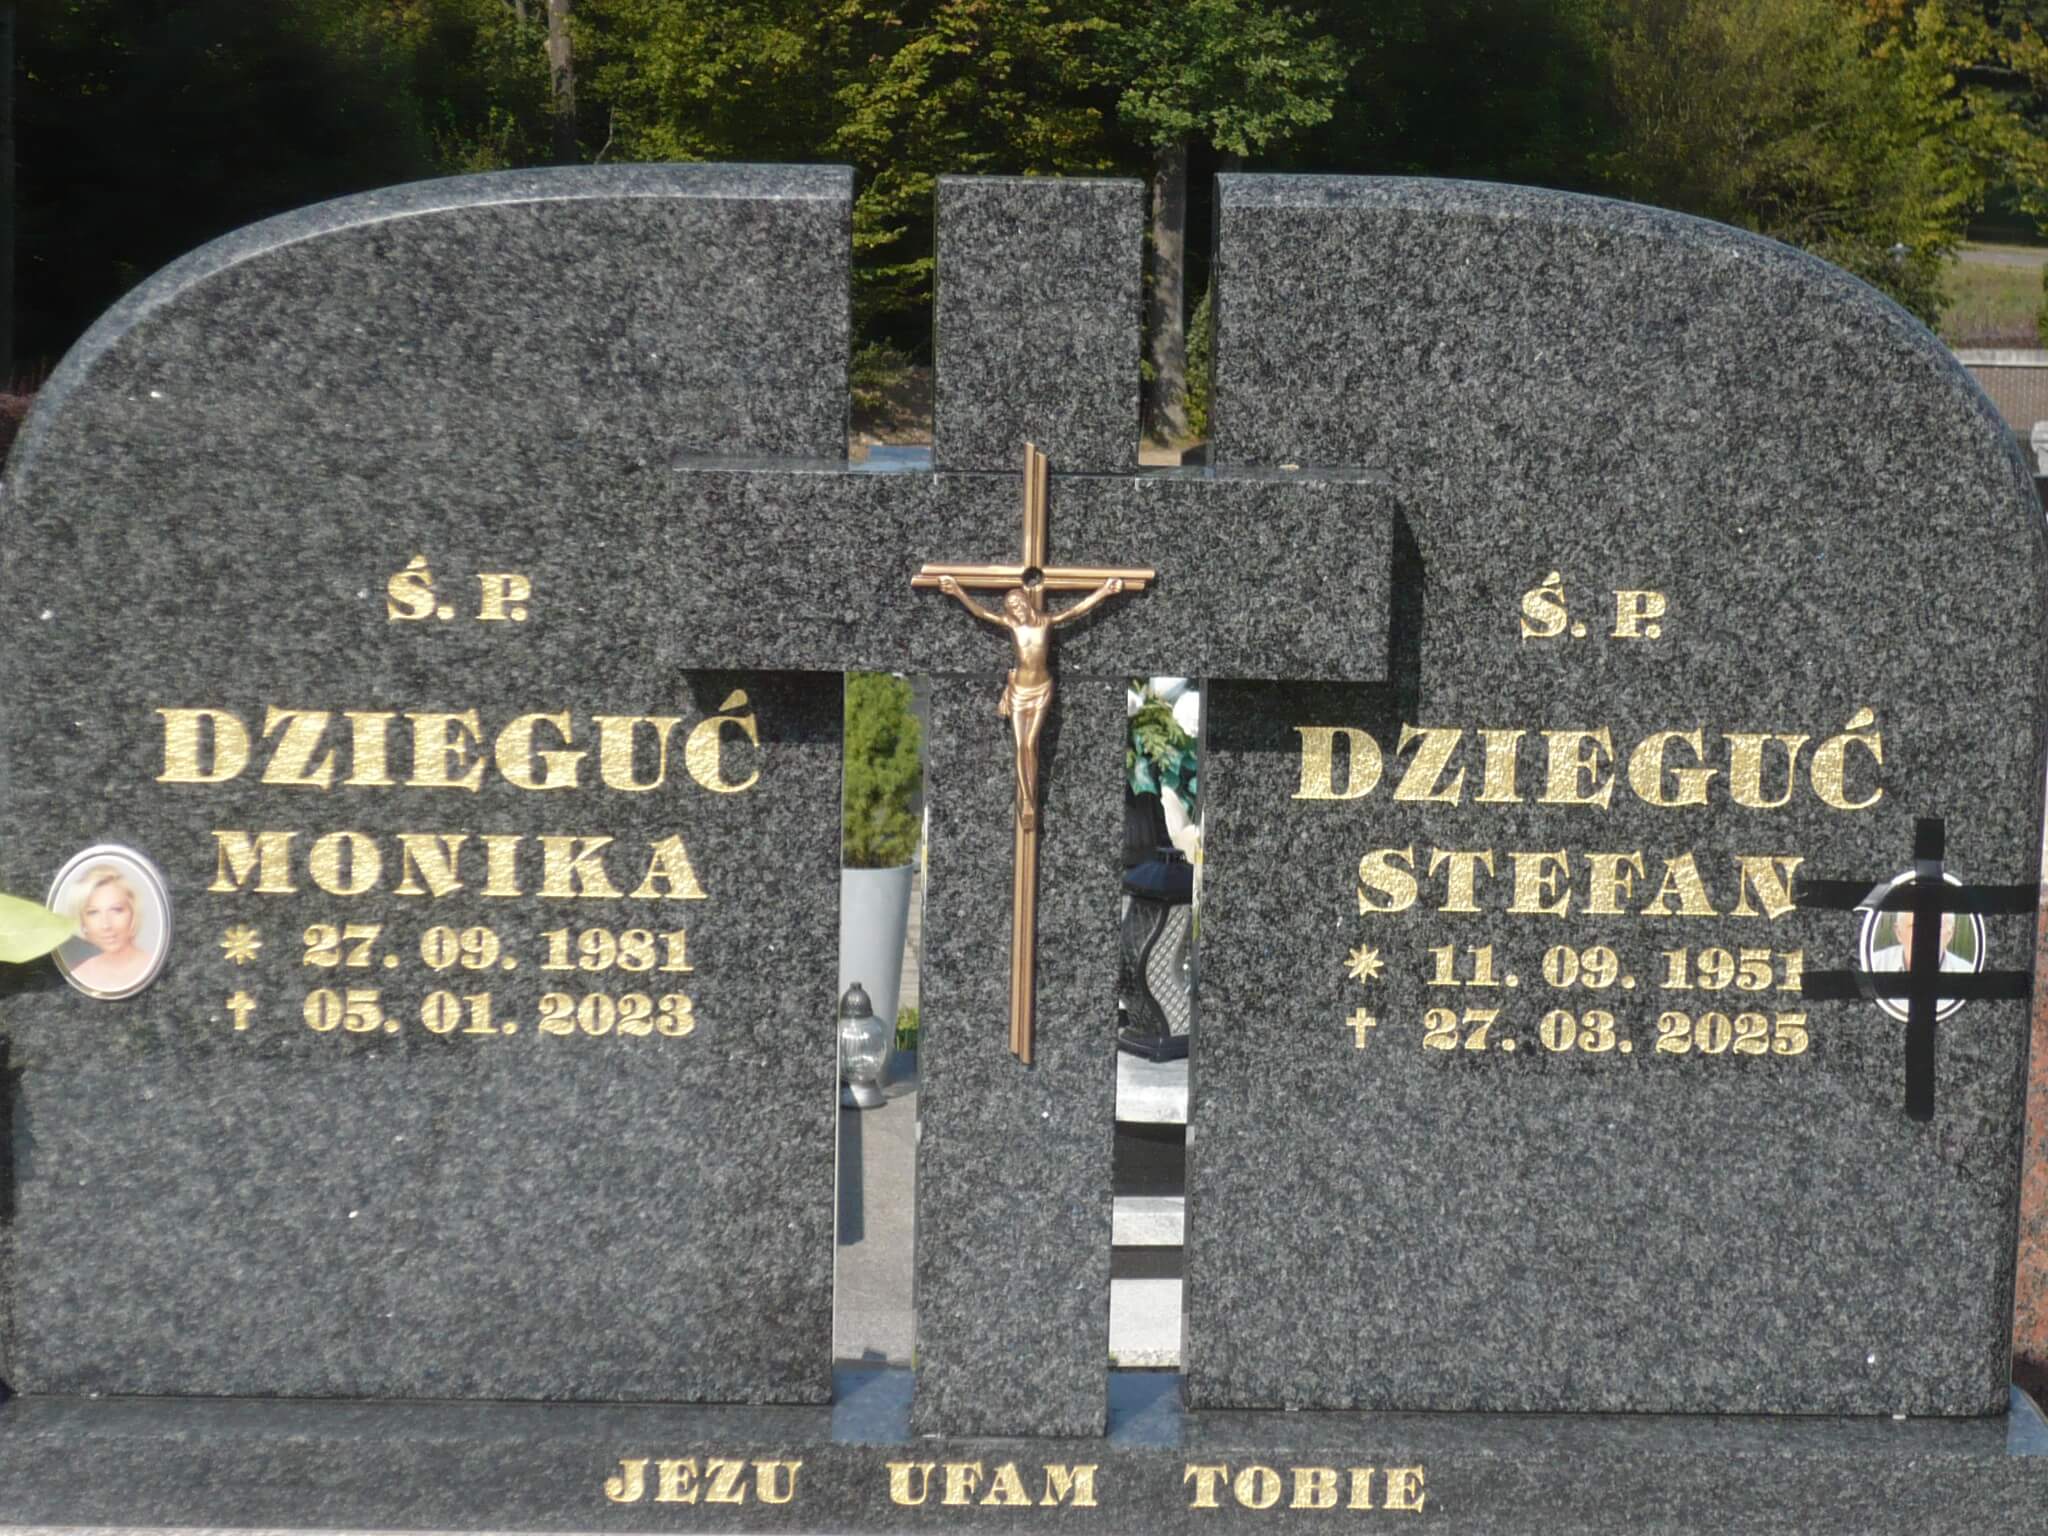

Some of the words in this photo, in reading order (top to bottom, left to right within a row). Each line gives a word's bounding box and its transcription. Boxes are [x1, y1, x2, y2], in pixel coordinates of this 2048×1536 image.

[387, 554, 455, 623] Ś.
[478, 572, 533, 622] P.
[1520, 570, 1588, 641] Ś.
[1611, 589, 1668, 640] P.
[155, 689, 762, 795] DZIEGUĆ
[1292, 706, 1884, 811] DZIEGUĆ
[207, 829, 708, 901] MONIKA
[1356, 846, 1805, 921] STEFAN
[302, 922, 400, 971] 27.
[420, 924, 518, 972] 09.
[542, 927, 695, 973] 1981
[1427, 943, 1520, 988] 11.
[1542, 944, 1636, 990] 09.
[1662, 946, 1804, 992] 1951
[302, 987, 401, 1035] 05.
[420, 990, 518, 1036] 01.
[537, 991, 696, 1037] 2023
[1423, 1007, 1516, 1052] 27.
[1540, 1009, 1633, 1054] 03.
[1656, 1011, 1809, 1056] 2025
[603, 1456, 803, 1505] JEZU
[885, 1459, 1099, 1508] UFAM
[1183, 1462, 1427, 1514] TOBIE
